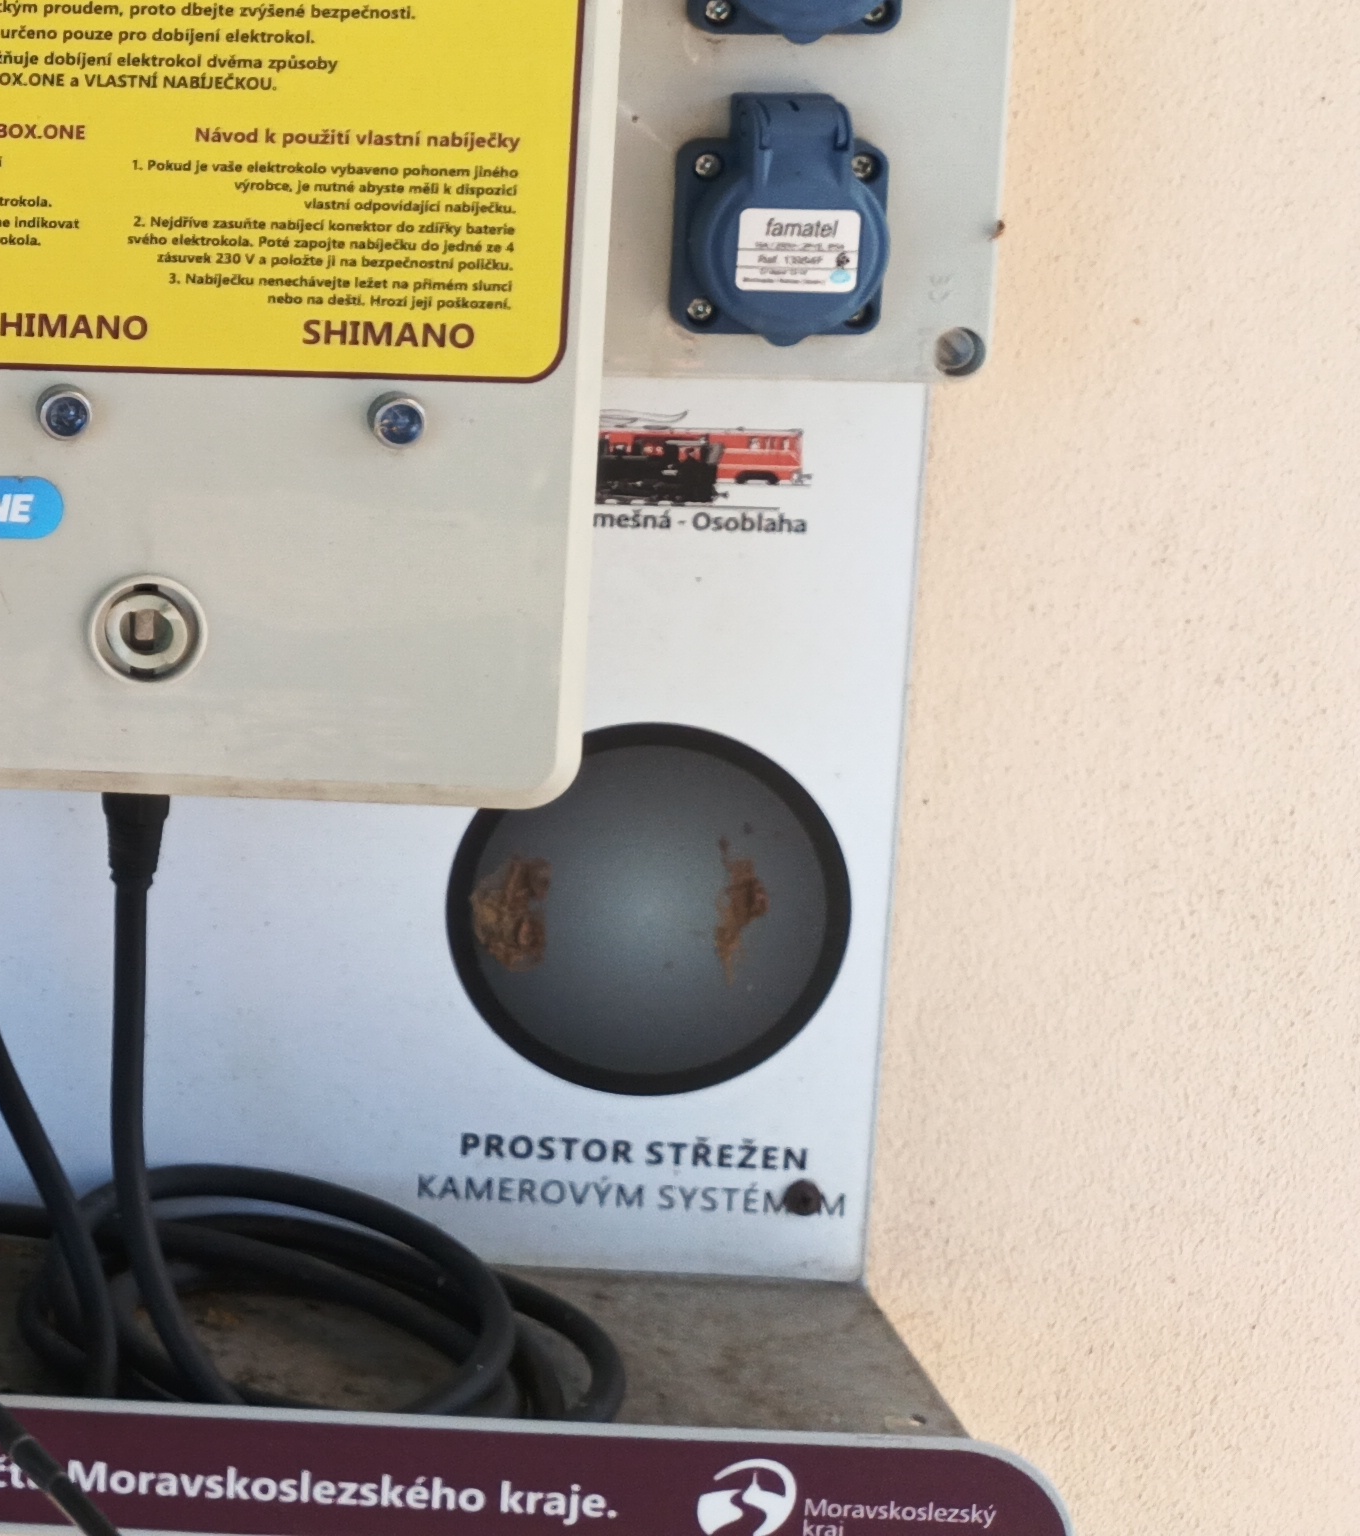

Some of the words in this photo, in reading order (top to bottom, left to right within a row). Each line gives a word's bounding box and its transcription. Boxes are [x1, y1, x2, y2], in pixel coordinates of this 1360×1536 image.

[764, 217, 840, 239] famatel
[302, 319, 475, 349] SHIMANO
[593, 508, 672, 530] mešná
[692, 511, 807, 534] Osoblaha
[460, 1132, 633, 1164] PROSTOR
[646, 1135, 808, 1171] STŘEŽEN
[417, 1173, 646, 1209] KAMEROVÝM
[658, 1182, 845, 1218] SYSTÉMM
[68, 1460, 486, 1513] Moravskoslezského
[499, 1479, 618, 1526] kraje.
[803, 1497, 997, 1530] Moravskoslezský
